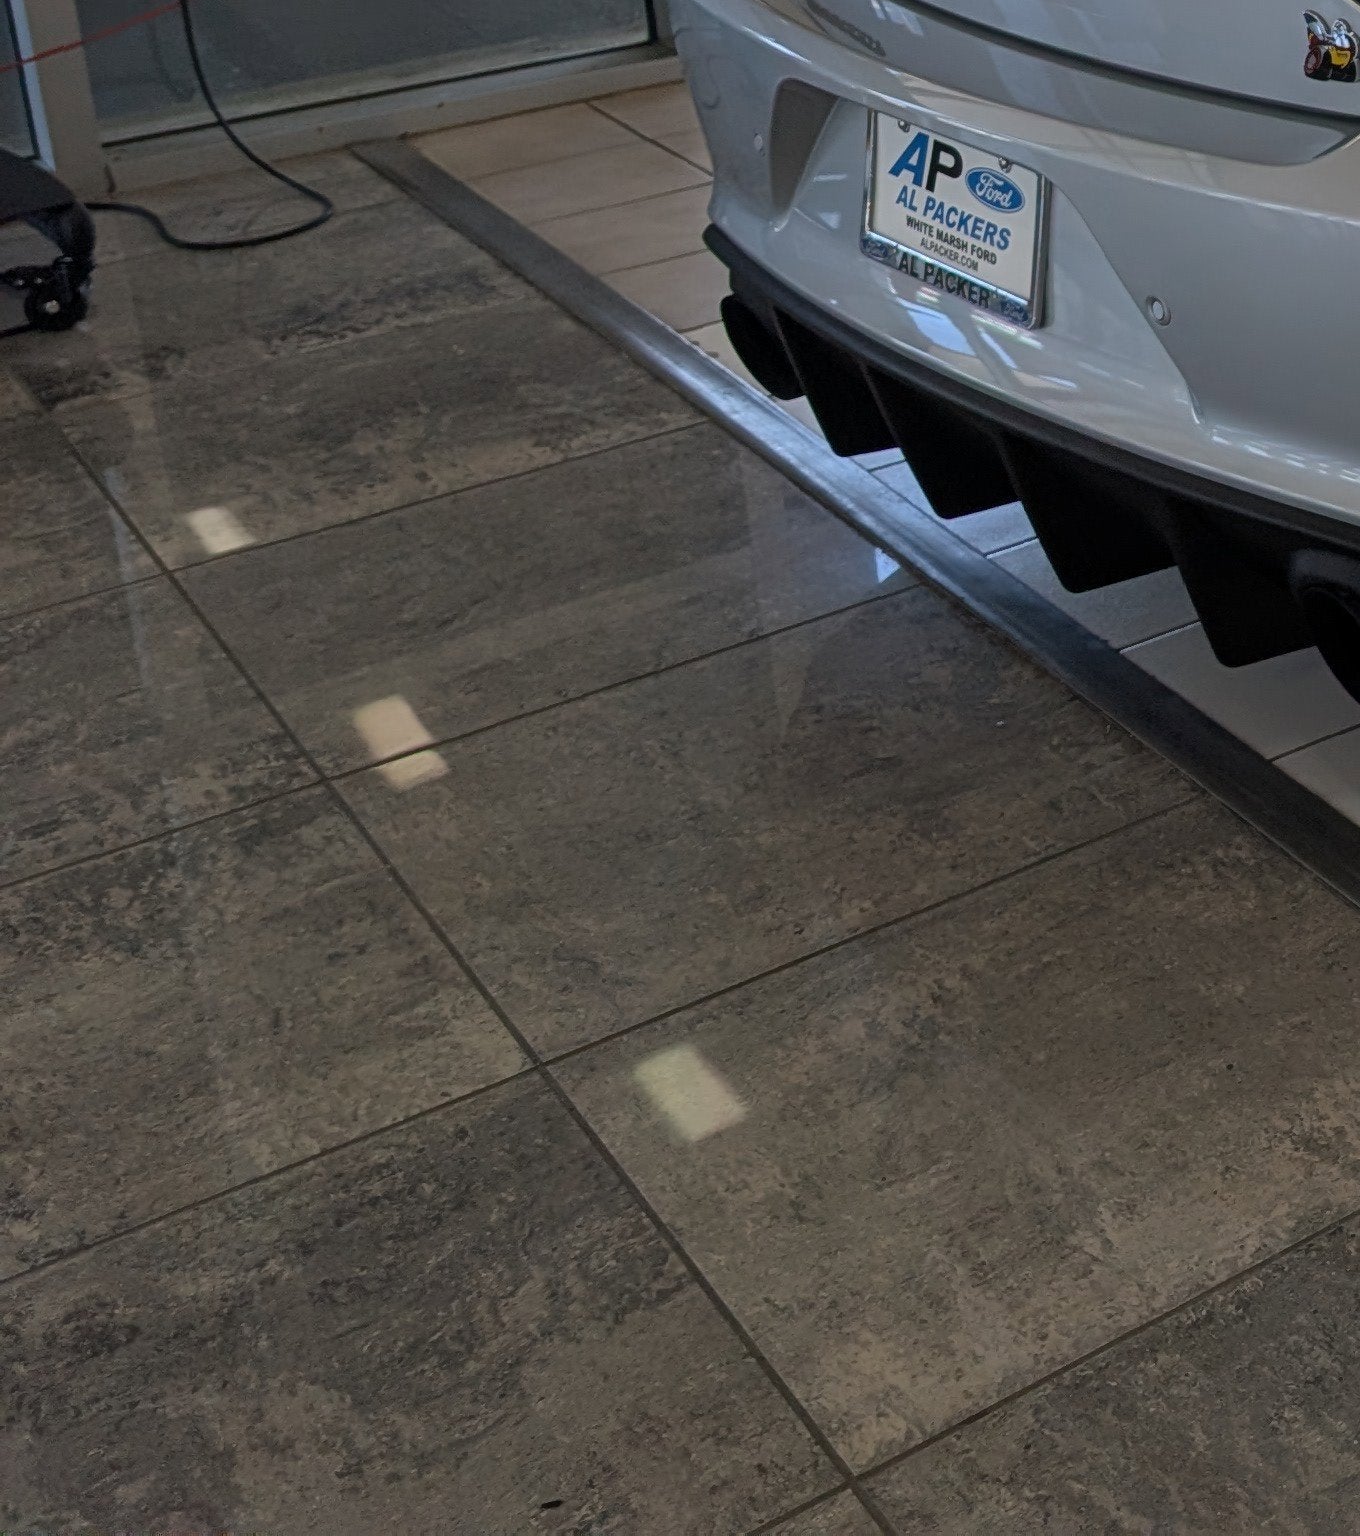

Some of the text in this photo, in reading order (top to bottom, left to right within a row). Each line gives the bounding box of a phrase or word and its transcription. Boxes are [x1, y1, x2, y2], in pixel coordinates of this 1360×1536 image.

[888, 131, 964, 193] AP
[974, 171, 1014, 209] Ford
[896, 185, 1012, 251] AL PACKERS
[906, 214, 997, 265] WHITE MARSH FORD
[900, 251, 990, 308] AL PACKER
[920, 237, 978, 271] ALPACKER.COM
